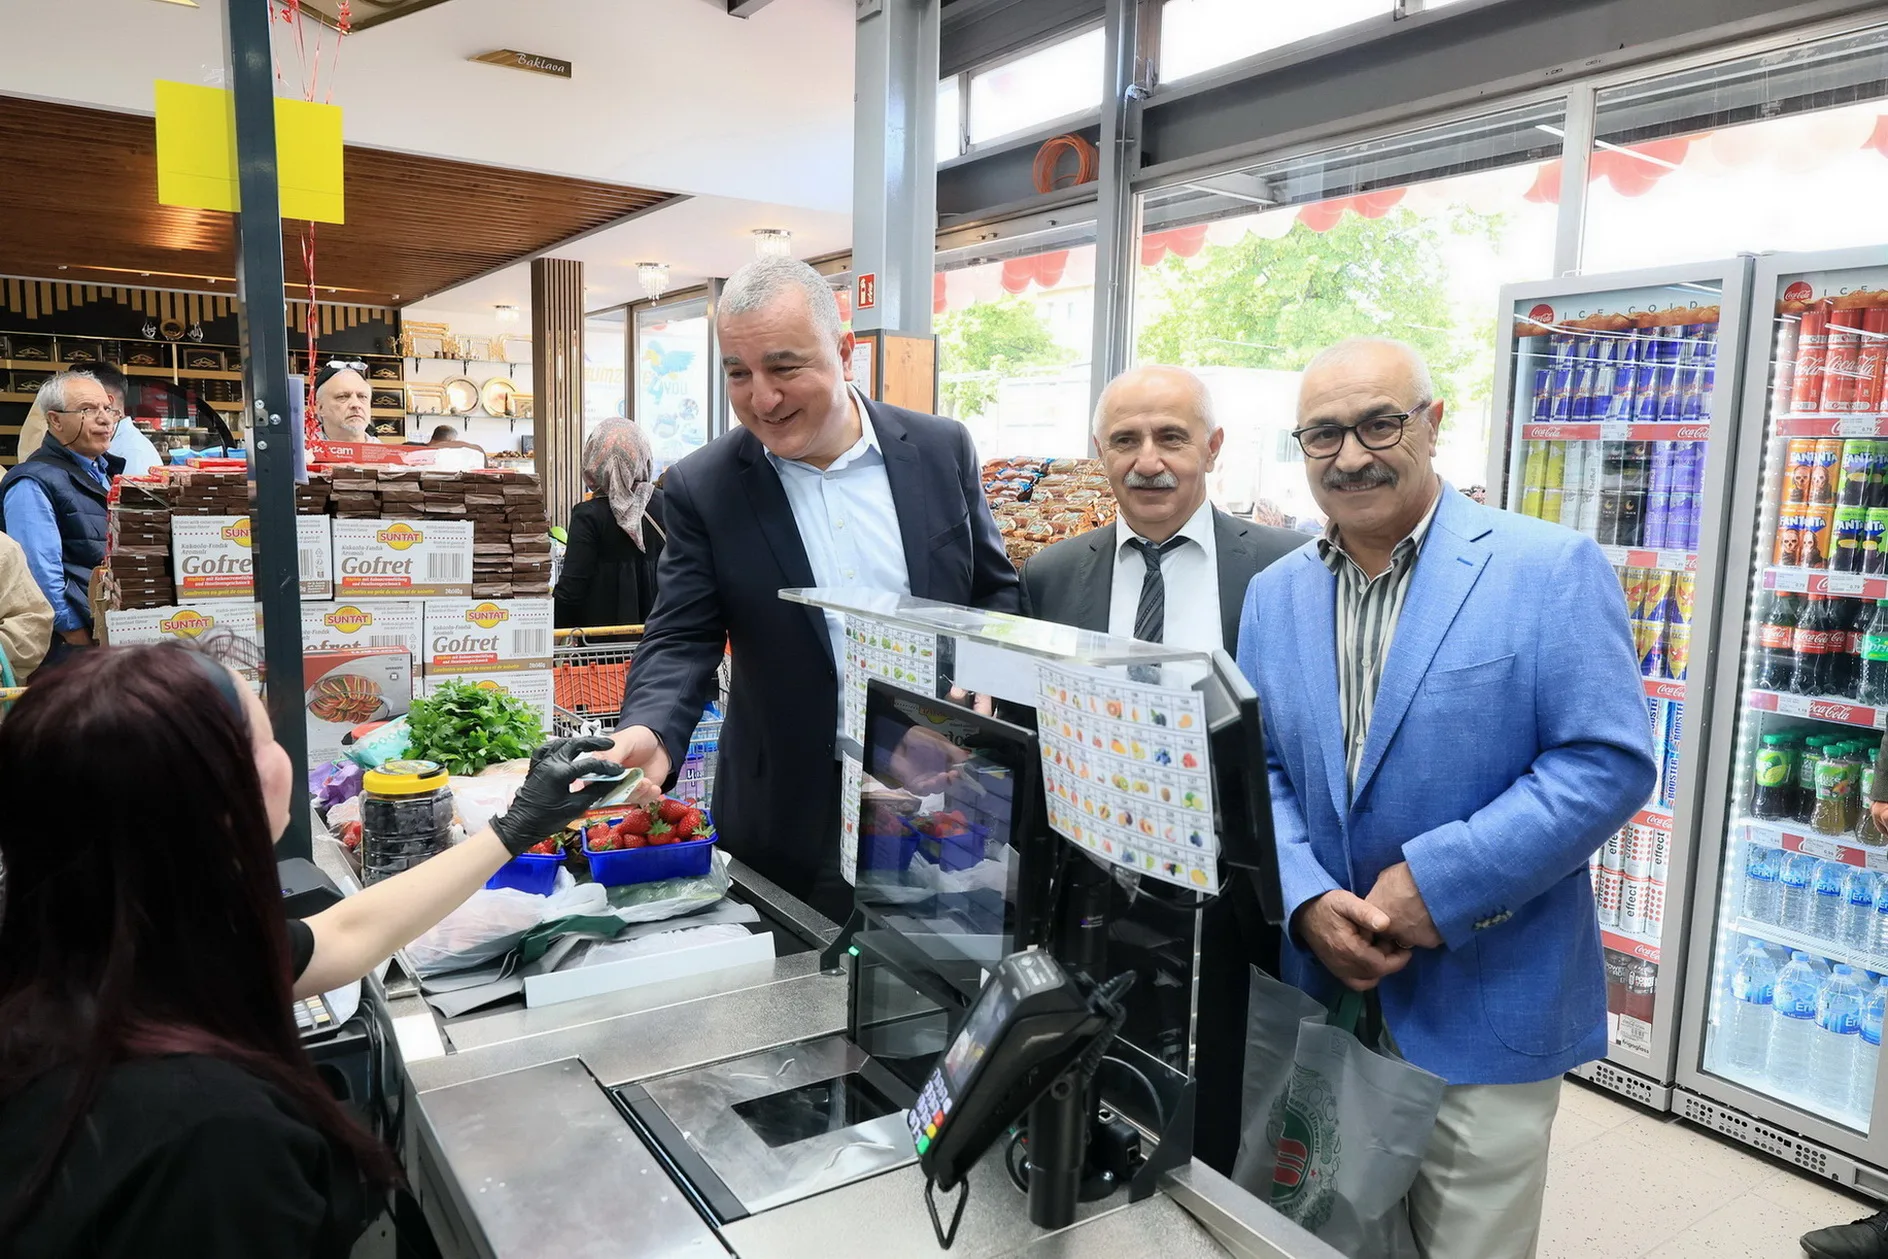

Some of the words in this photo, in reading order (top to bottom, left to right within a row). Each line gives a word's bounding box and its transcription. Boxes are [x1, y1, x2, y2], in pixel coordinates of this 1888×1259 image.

[516, 52, 565, 73] Baklava
[1790, 451, 1815, 465] FANT
[1780, 516, 1805, 528] FANT
[225, 528, 251, 537] SUN
[380, 533, 420, 541] SUNTAT
[181, 554, 251, 575] Gofre
[341, 556, 413, 575] Gofret
[164, 618, 210, 631] SUNTAT
[327, 615, 368, 625] SUNTAT
[469, 611, 505, 620] SUNTAT
[432, 635, 499, 654] Gofret
[1668, 758, 1678, 799] BOOSTER
[1655, 832, 1665, 865] effect
[1626, 885, 1637, 917] effect
[1308, 1112, 1321, 1154] Umwelt
